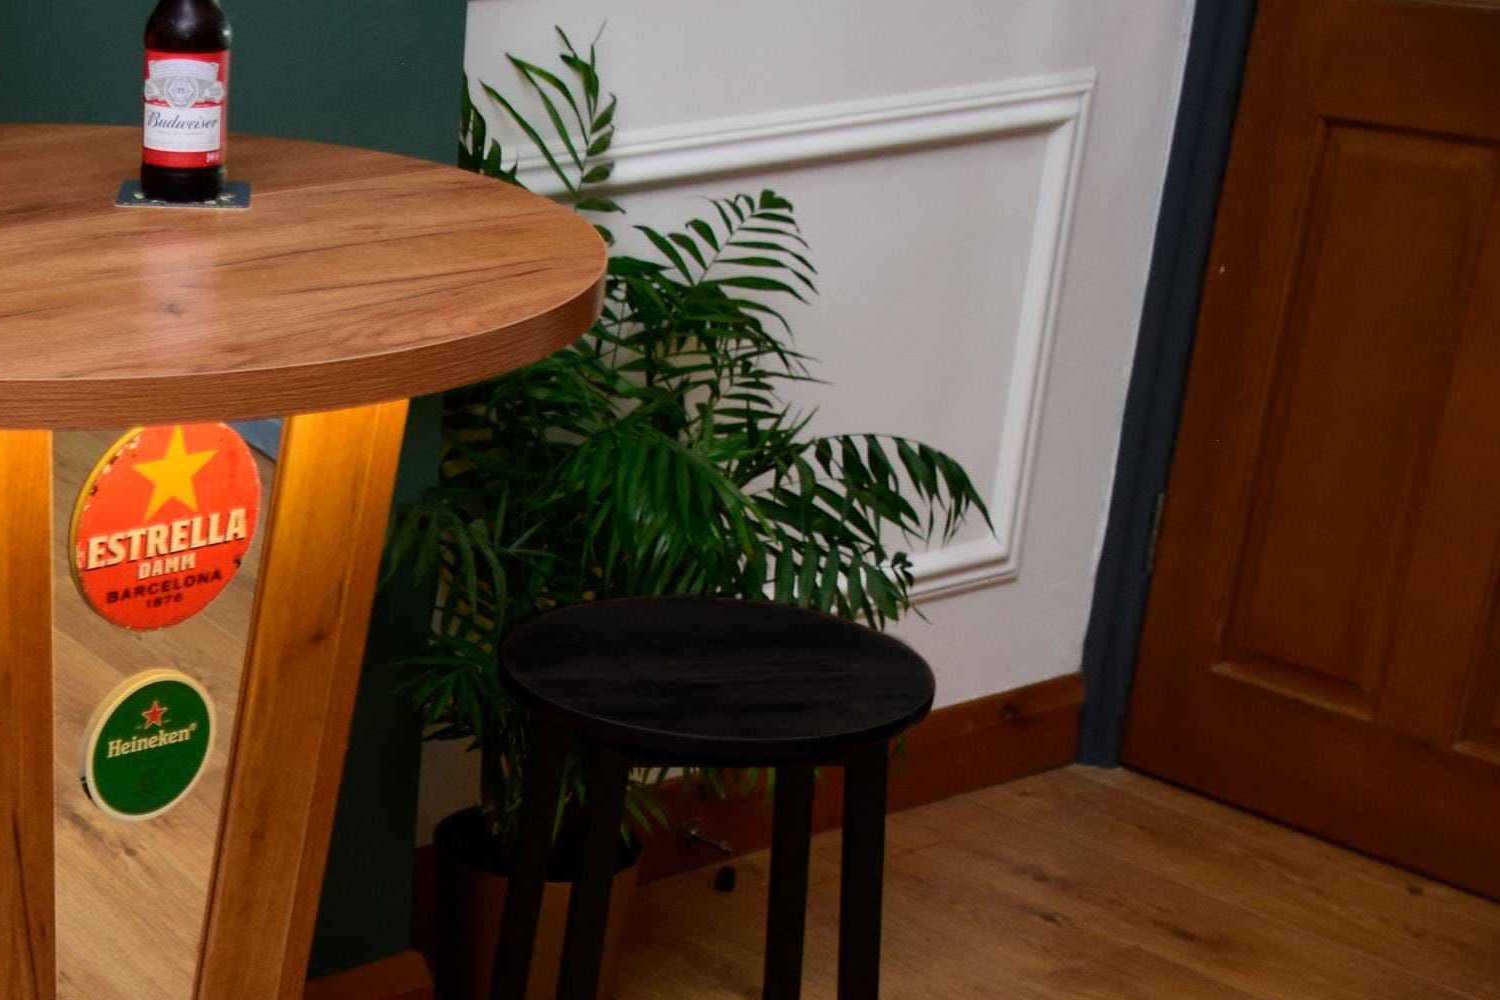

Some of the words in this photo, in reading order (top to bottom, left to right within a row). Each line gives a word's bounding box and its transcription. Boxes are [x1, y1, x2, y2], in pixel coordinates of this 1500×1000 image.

[147, 111, 218, 129] Budweiser
[86, 508, 248, 570] ESTRELLA
[138, 553, 196, 580] DAMM
[106, 569, 222, 604] BARCELONA
[146, 593, 183, 609] 1876
